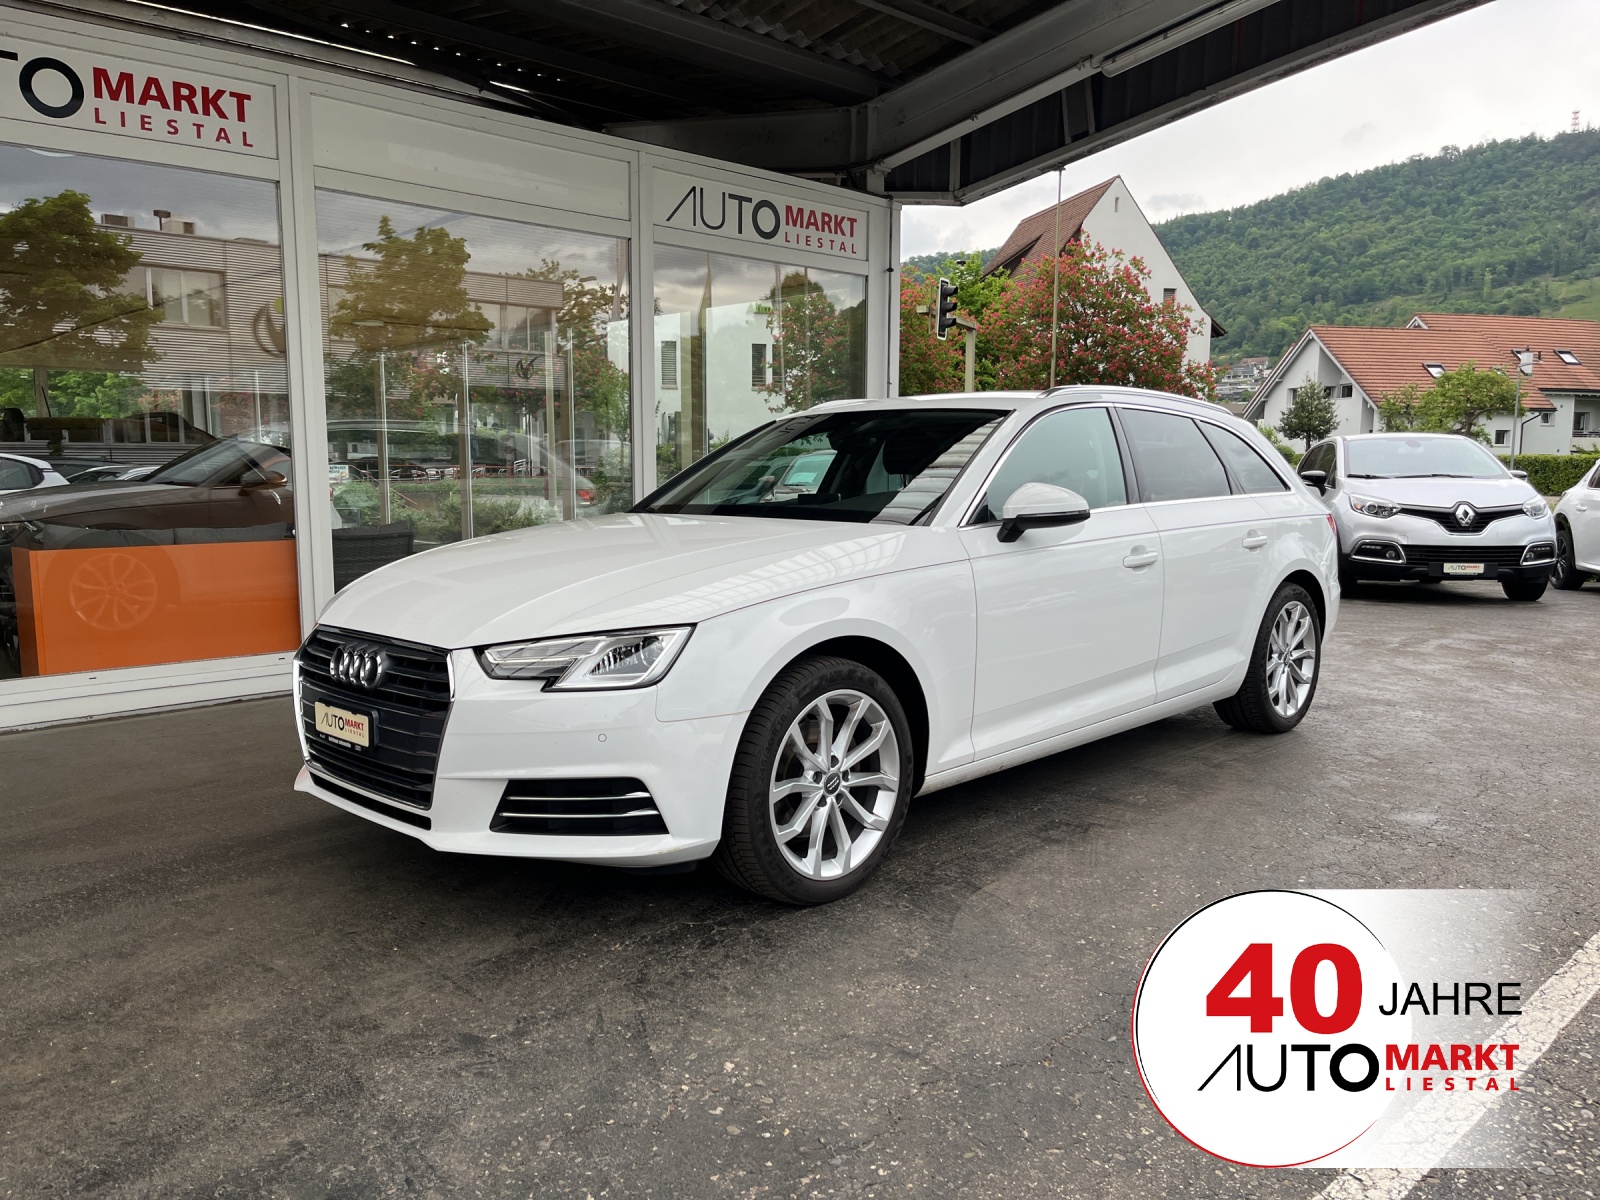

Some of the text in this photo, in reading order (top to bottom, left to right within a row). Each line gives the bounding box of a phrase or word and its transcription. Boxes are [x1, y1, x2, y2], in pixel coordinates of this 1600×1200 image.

[93, 67, 252, 123] MARKT
[94, 107, 254, 148] LIESTAL
[666, 186, 857, 240] AUTO MARKT
[784, 232, 857, 254] LIESTAL
[320, 712, 364, 731] AUTO MARKT
